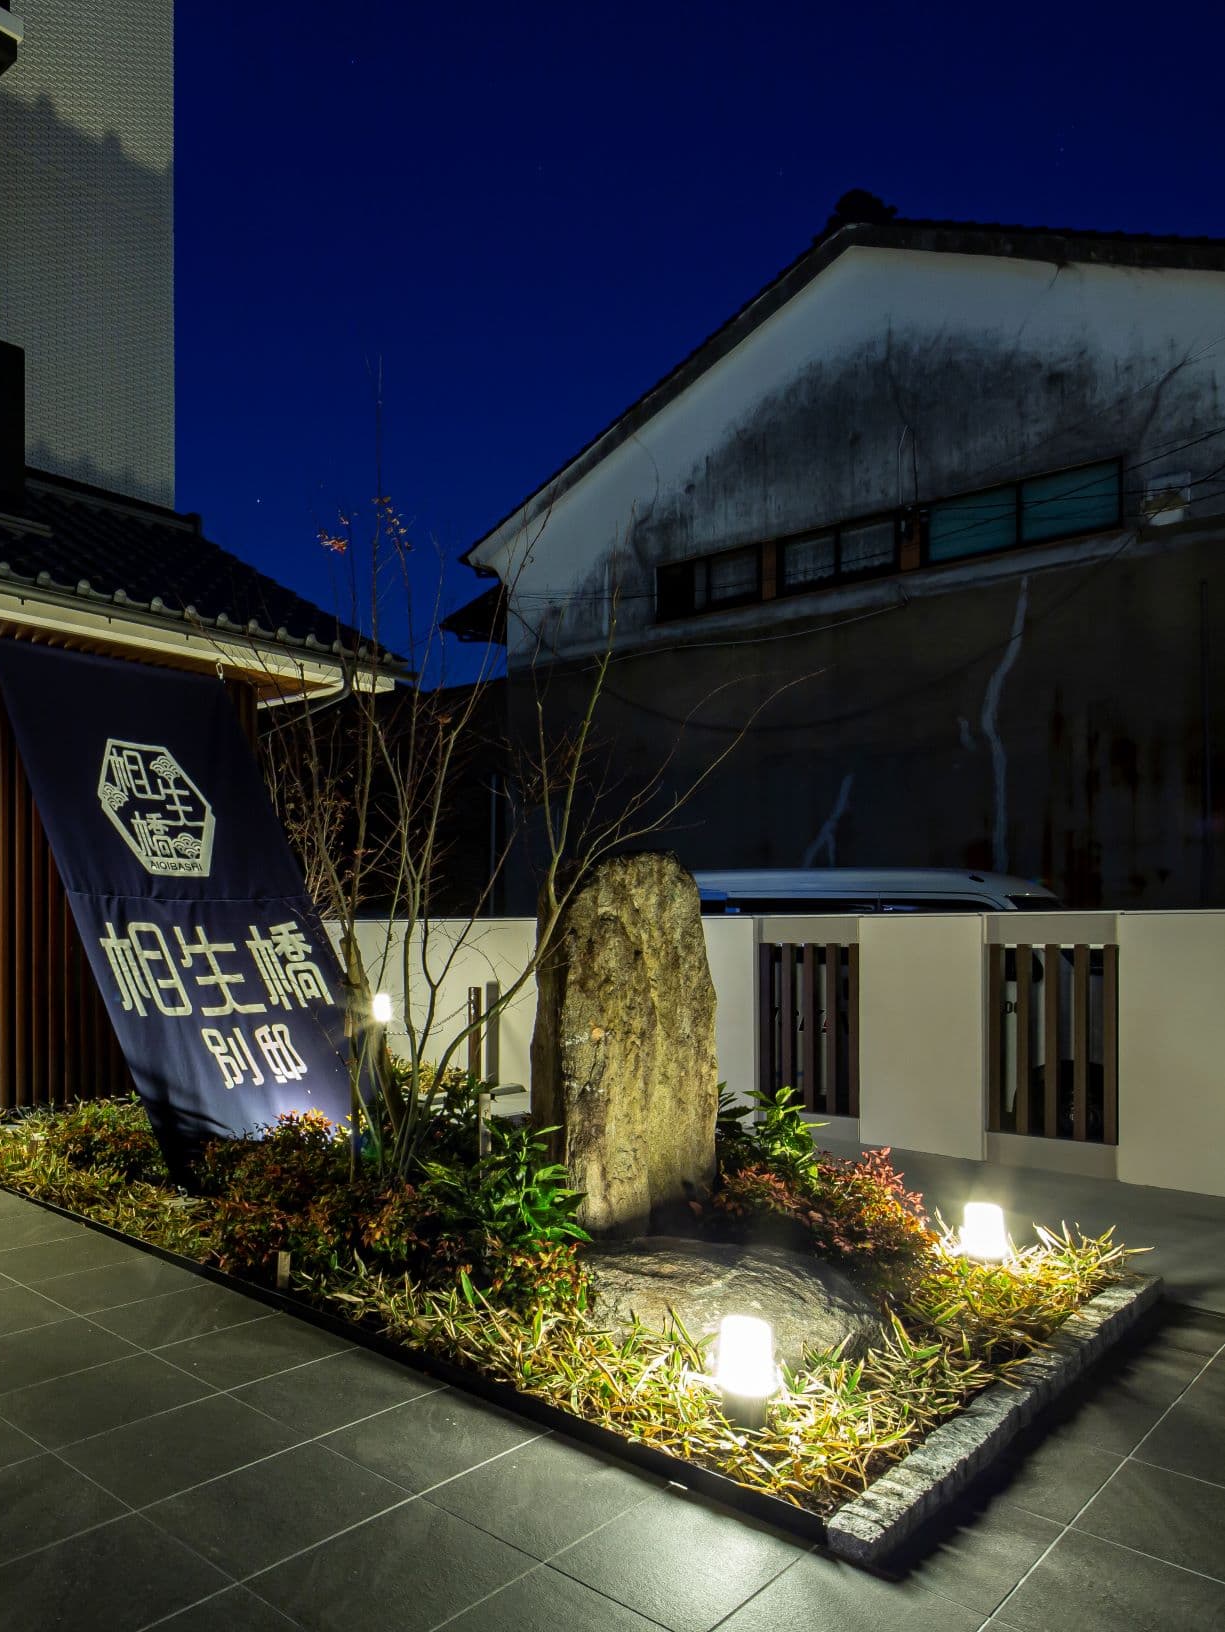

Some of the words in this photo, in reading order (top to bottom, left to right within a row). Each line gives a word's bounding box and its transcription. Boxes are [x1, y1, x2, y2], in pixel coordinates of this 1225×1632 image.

[150, 860, 204, 872] AIOIBASHI
[100, 920, 334, 1017] 相生橋
[201, 1023, 308, 1090] 別邸
